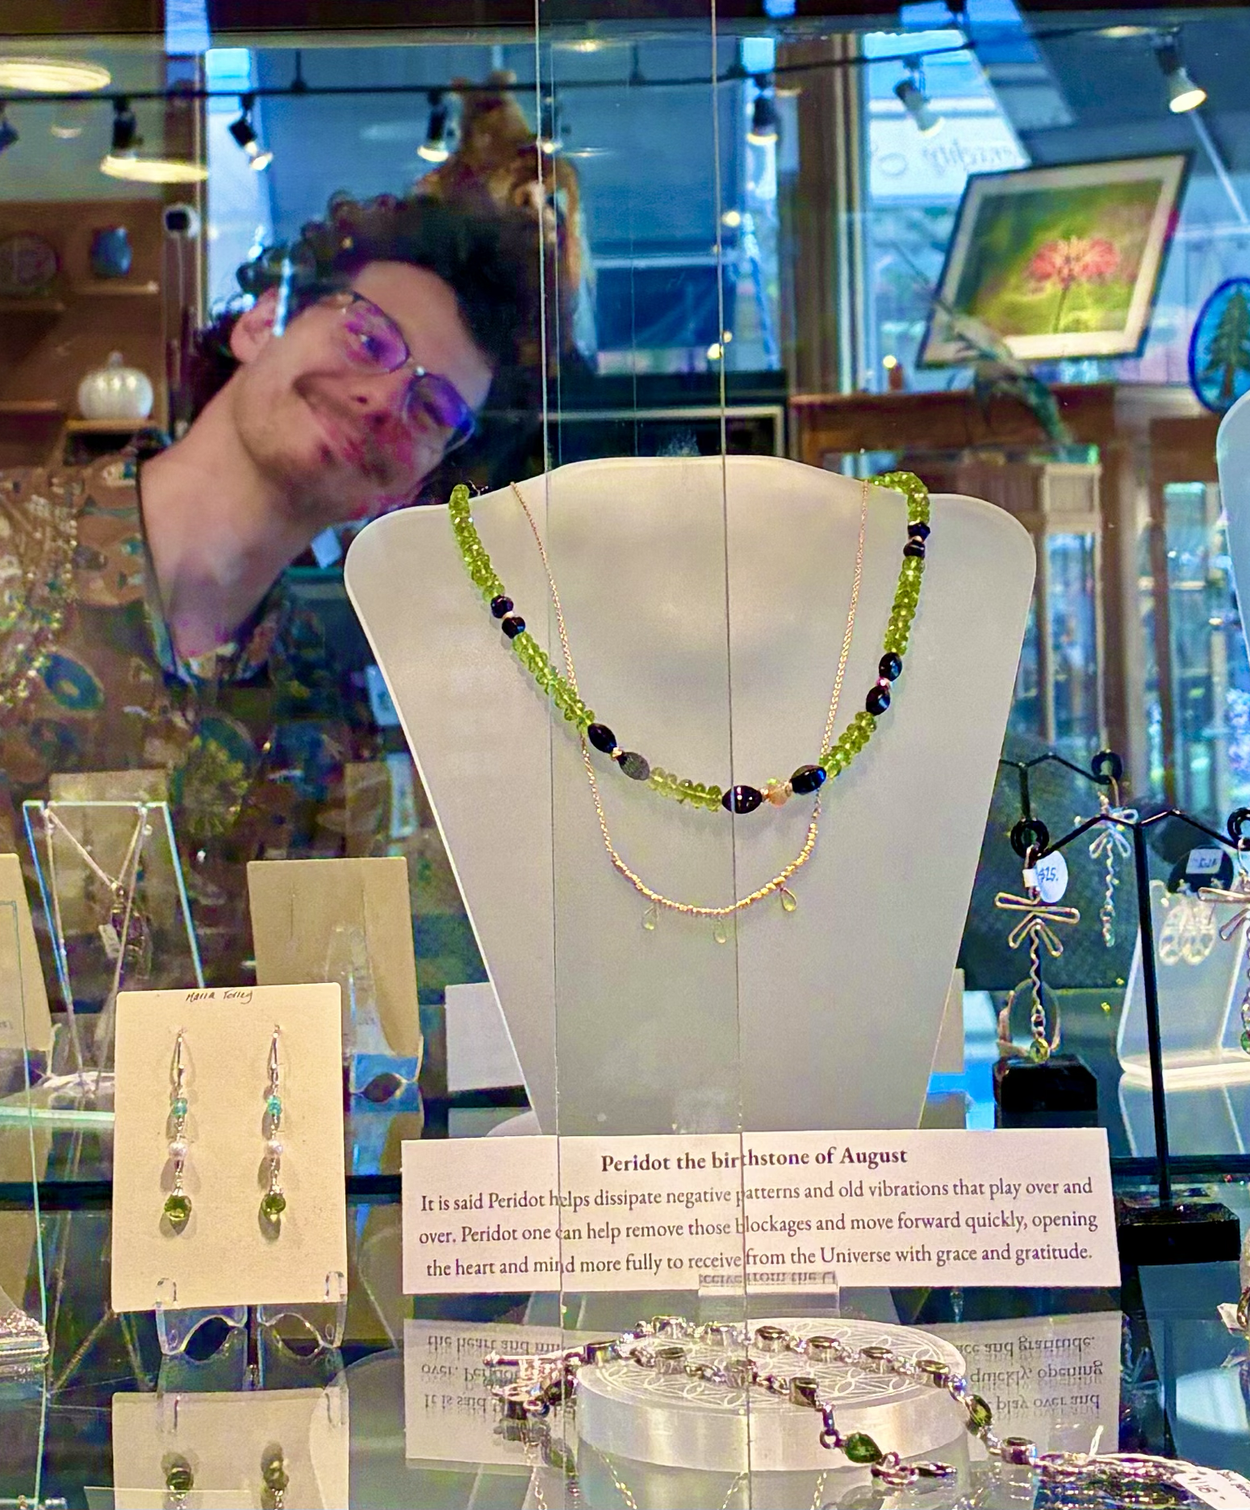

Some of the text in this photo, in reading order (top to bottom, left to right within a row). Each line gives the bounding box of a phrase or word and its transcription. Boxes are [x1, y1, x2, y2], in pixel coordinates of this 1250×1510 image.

[601, 1147, 908, 1172] Peridot the birthstone of August
[421, 1177, 1093, 1213] It is said Peridot helps dissipate negative patterns and old vibrations that play over and
[419, 1210, 1099, 1245] over. Peridot one can help remove those blockages and move forward quickly, opening
[427, 1242, 1093, 1276] the heart and mind more fully to receive from the Universe with grace and gratitude.
